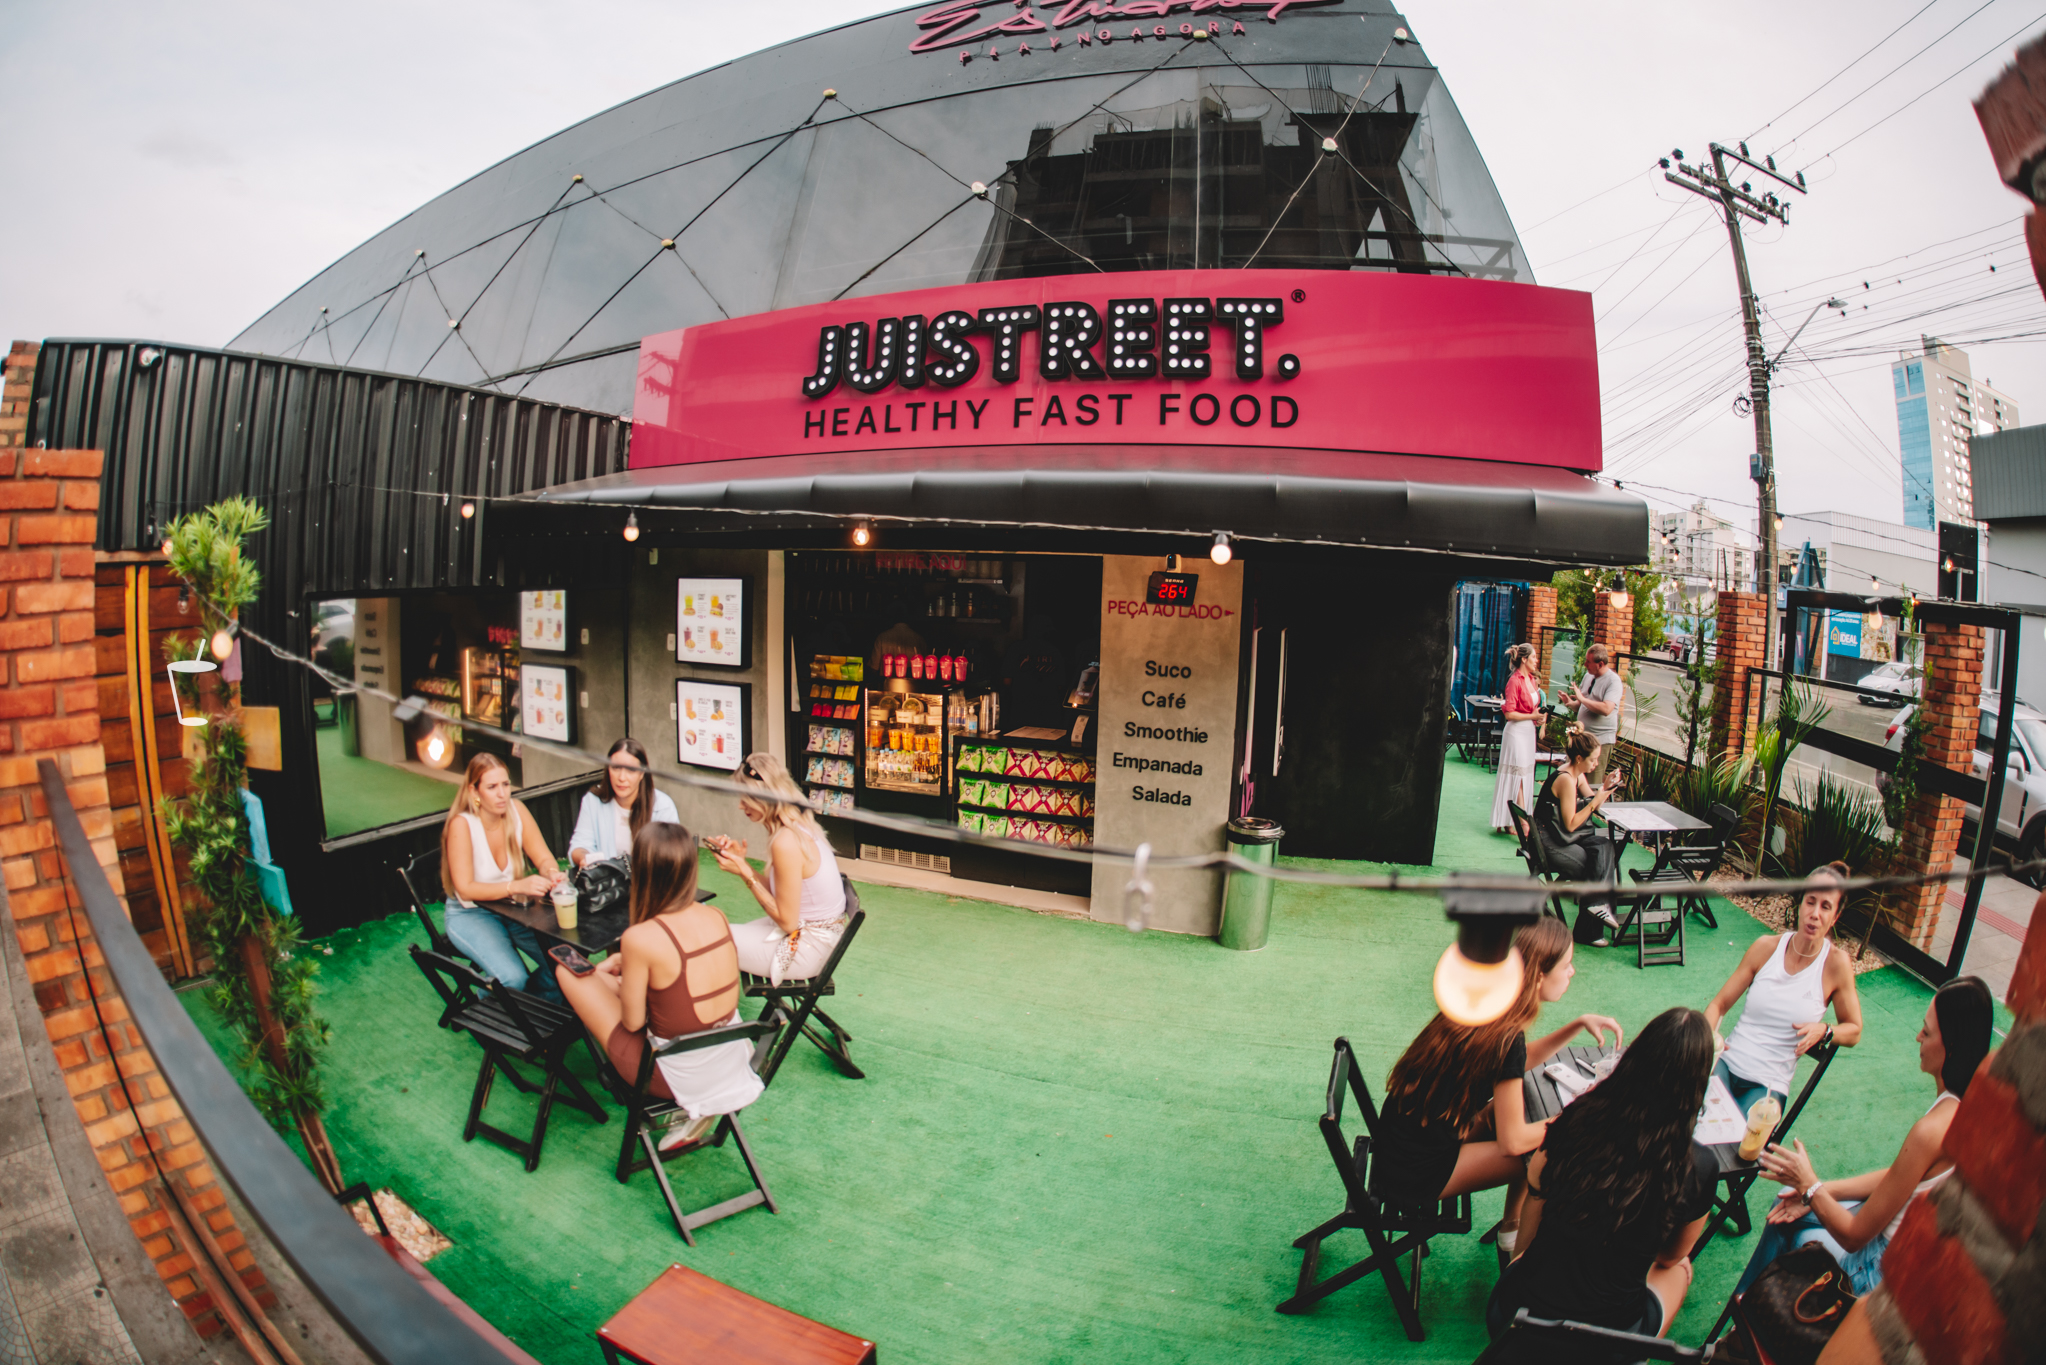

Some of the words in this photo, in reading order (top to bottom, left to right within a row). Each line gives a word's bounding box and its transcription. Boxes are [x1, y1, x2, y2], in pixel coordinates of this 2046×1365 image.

[959, 36, 1060, 63] PLAY
[1077, 29, 1112, 44] NO
[1130, 21, 1246, 37] AGORA
[804, 398, 990, 438] HEALTHY
[1013, 393, 1133, 428] FAST
[1160, 393, 1299, 428] FOOD
[928, 554, 967, 570] AQUI
[1108, 600, 1148, 619] PEÇA
[1152, 603, 1176, 617] AO
[1179, 604, 1223, 620] LADO
[1145, 660, 1192, 679] Suco
[1141, 690, 1187, 709] Café
[1124, 722, 1209, 743] Smoothie
[1113, 752, 1203, 776] Empanada
[1132, 785, 1192, 806] Salada
